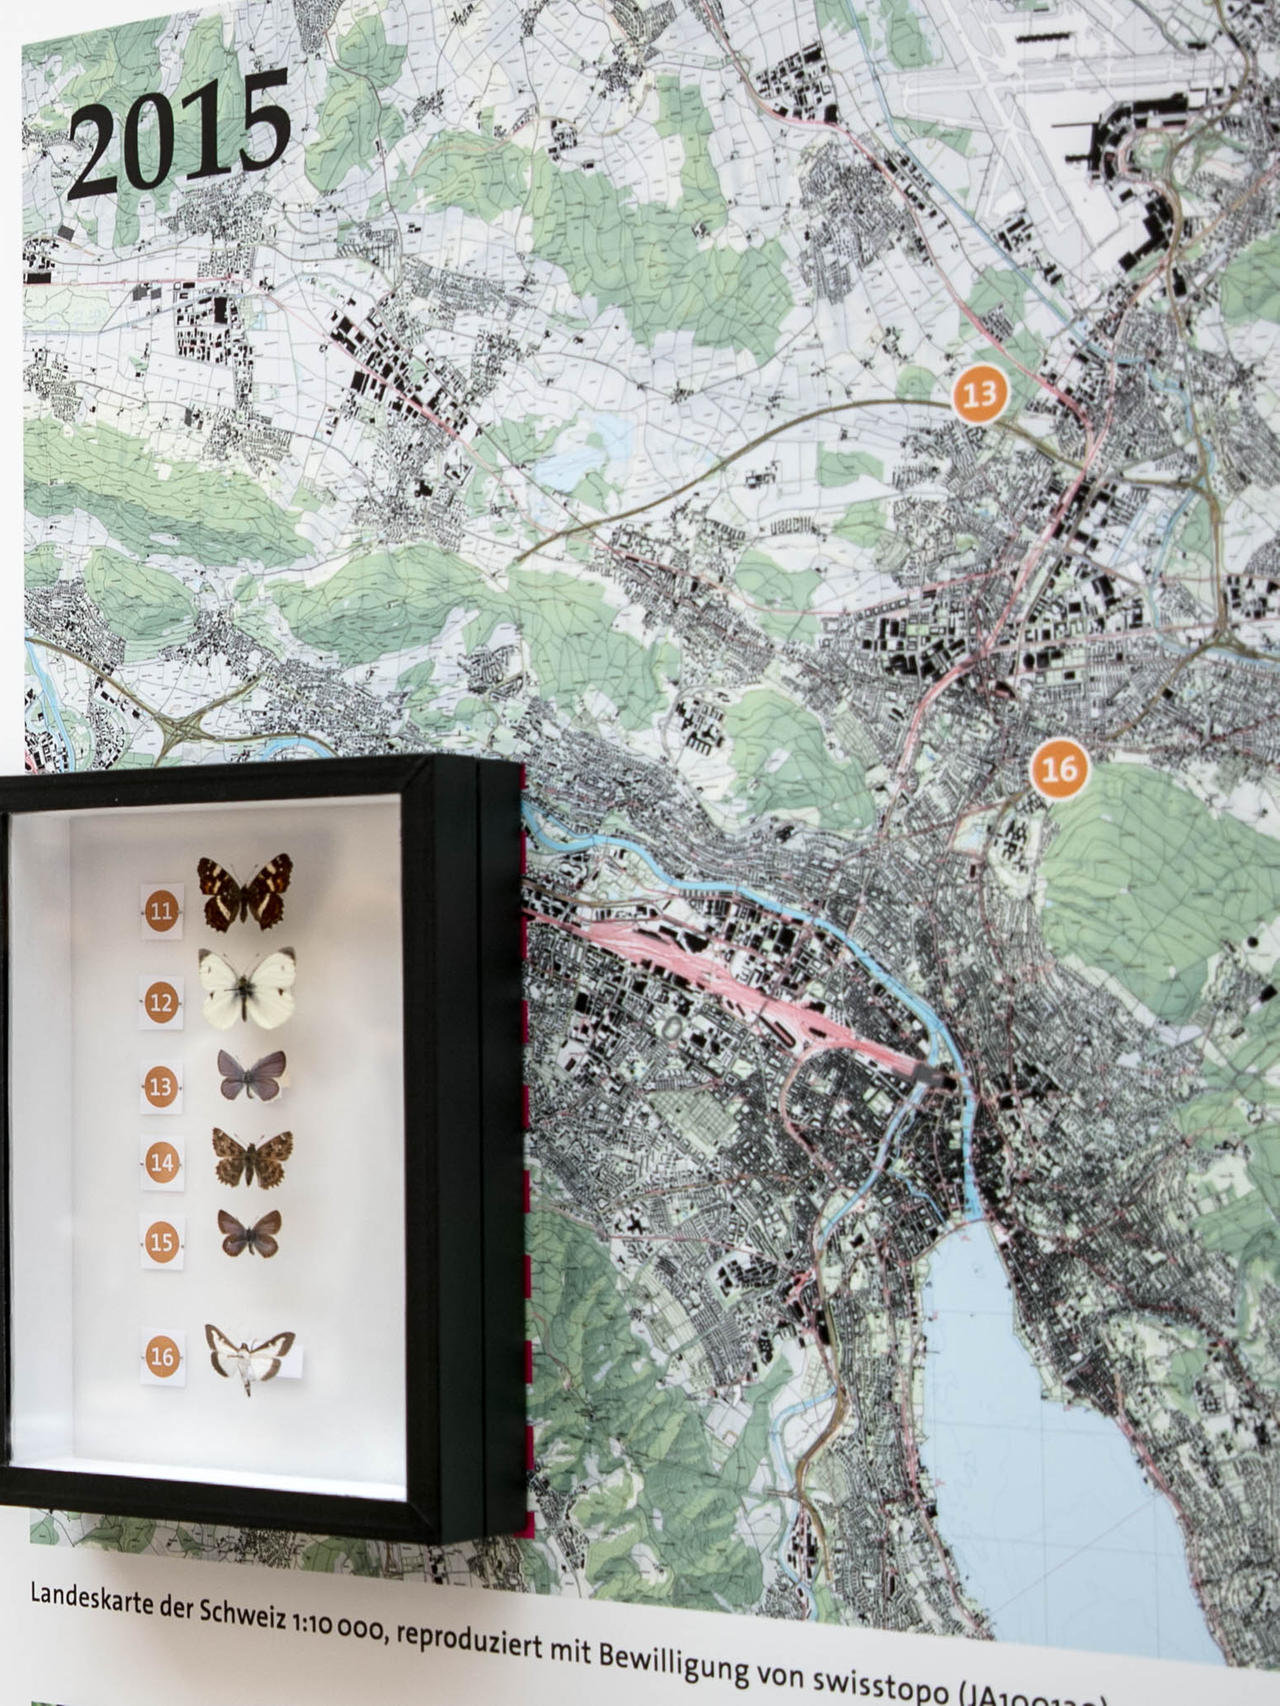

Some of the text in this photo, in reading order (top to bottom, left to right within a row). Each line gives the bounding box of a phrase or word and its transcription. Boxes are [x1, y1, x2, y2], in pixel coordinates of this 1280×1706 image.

[67, 66, 291, 201] 2015
[963, 380, 997, 409] 13
[1042, 755, 1079, 783] 16
[151, 902, 173, 921] 11
[150, 993, 172, 1012] 12
[150, 1077, 172, 1097] 13
[151, 1153, 174, 1172] 14
[151, 1233, 173, 1252] 15
[151, 1347, 174, 1367] 16
[31, 1580, 154, 1616] Landeskarte
[159, 1593, 194, 1620] der
[200, 1597, 287, 1630] Schweiz
[292, 1612, 333, 1635] 1:10
[337, 1617, 390, 1645] 000,
[397, 1622, 543, 1659] reproduziert
[551, 1637, 592, 1665] mit
[600, 1642, 750, 1690] Bewilligung
[757, 1663, 804, 1689] von
[813, 1667, 950, 1706] swisstopo
